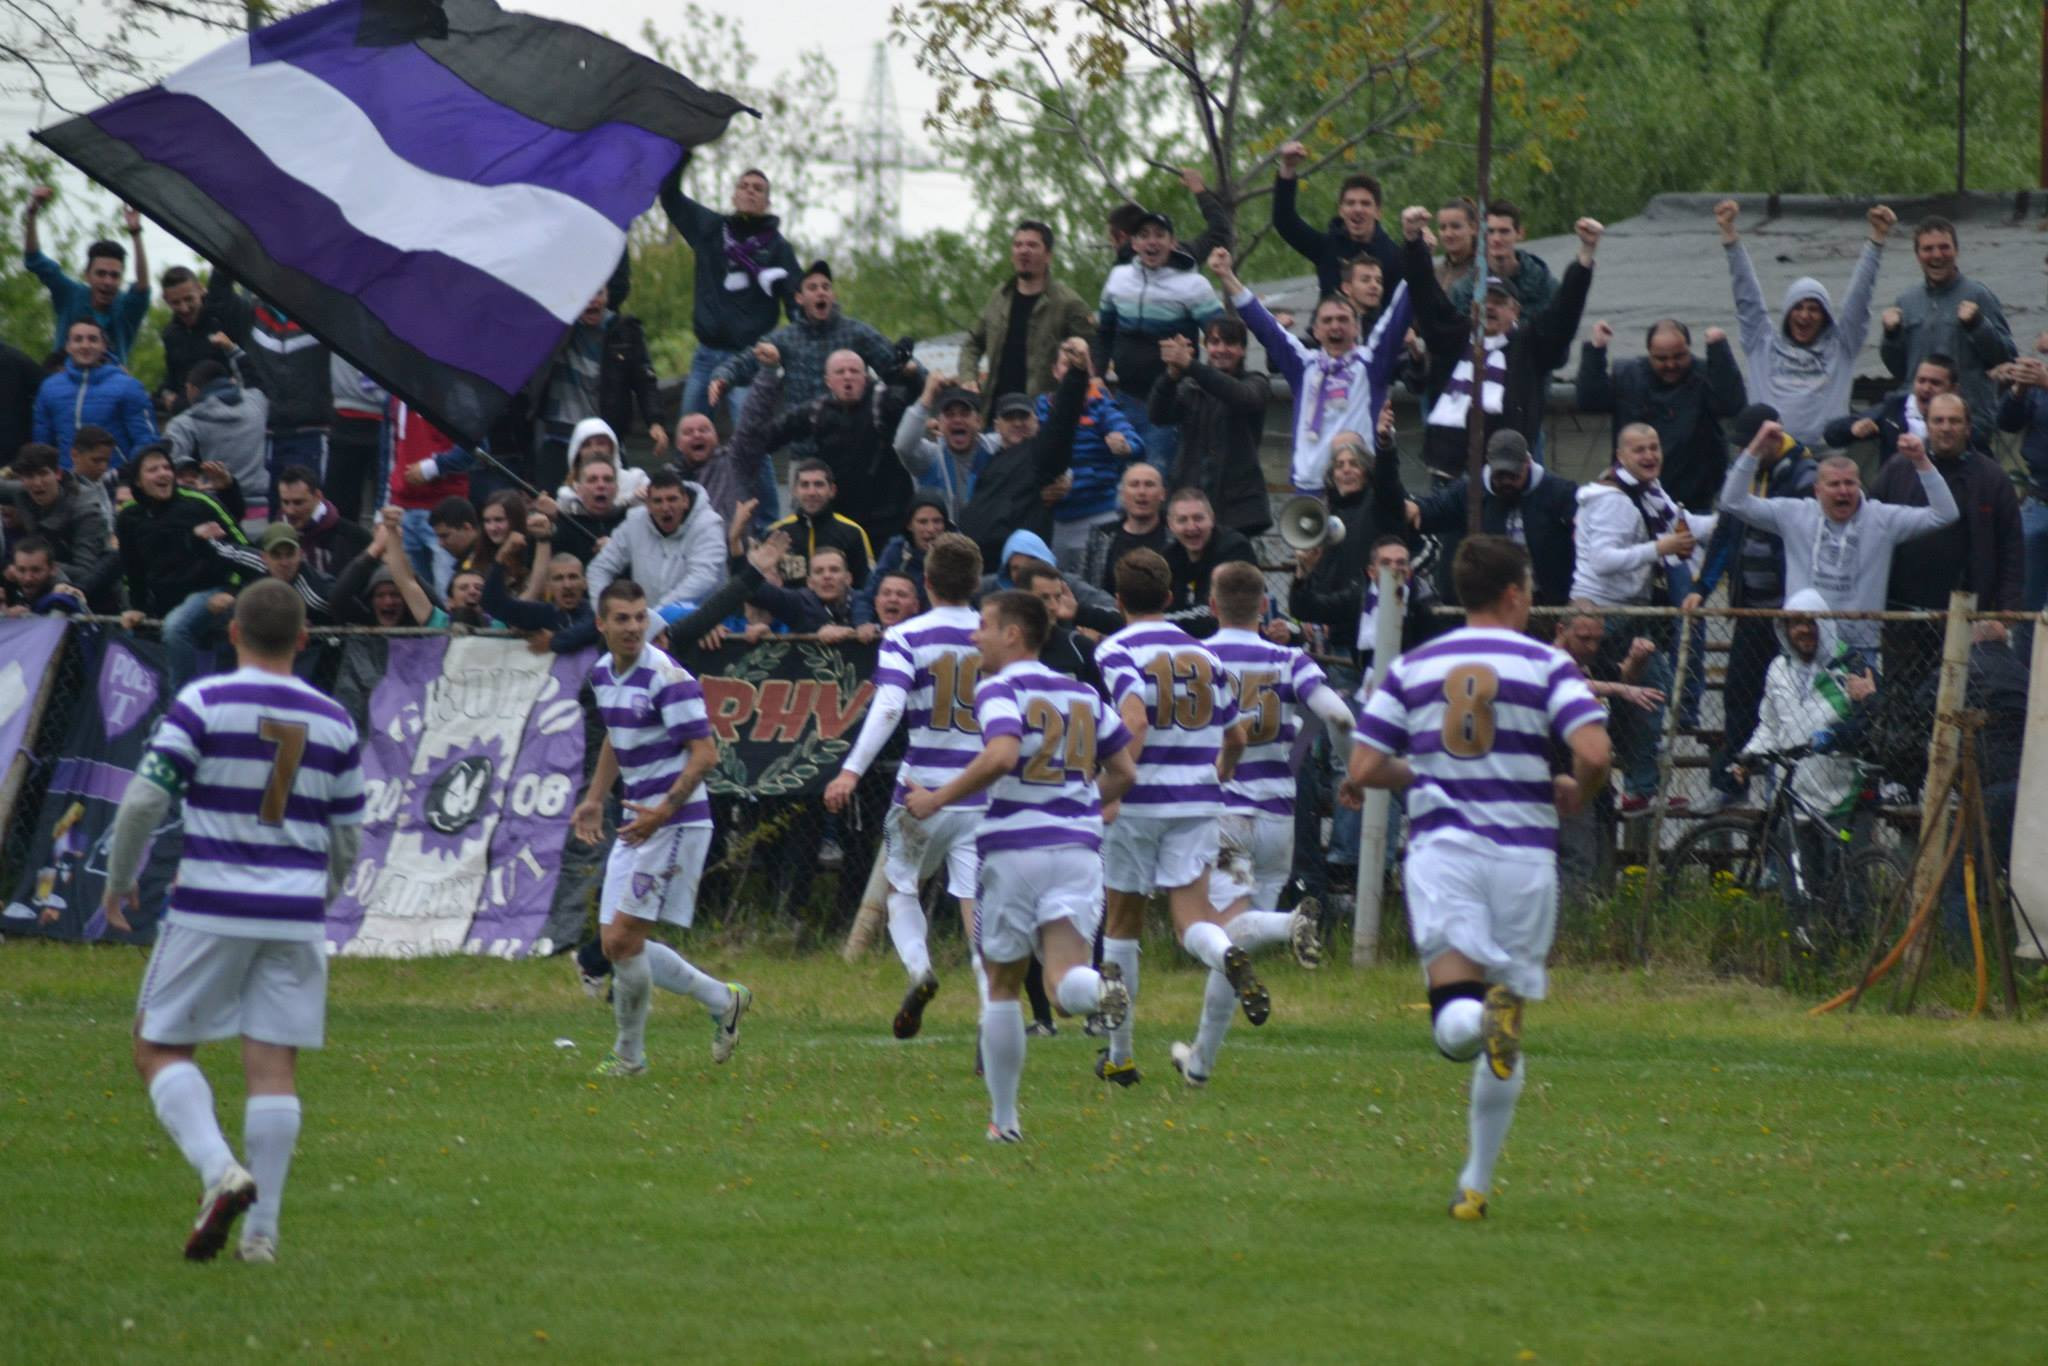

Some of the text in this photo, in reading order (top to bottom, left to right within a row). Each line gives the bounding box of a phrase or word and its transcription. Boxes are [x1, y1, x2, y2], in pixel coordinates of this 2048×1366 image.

[1144, 650, 1215, 731] 13
[1441, 662, 1499, 760] 8
[258, 717, 308, 827] 7
[1021, 697, 1097, 787] 24
[511, 773, 572, 817] 08
